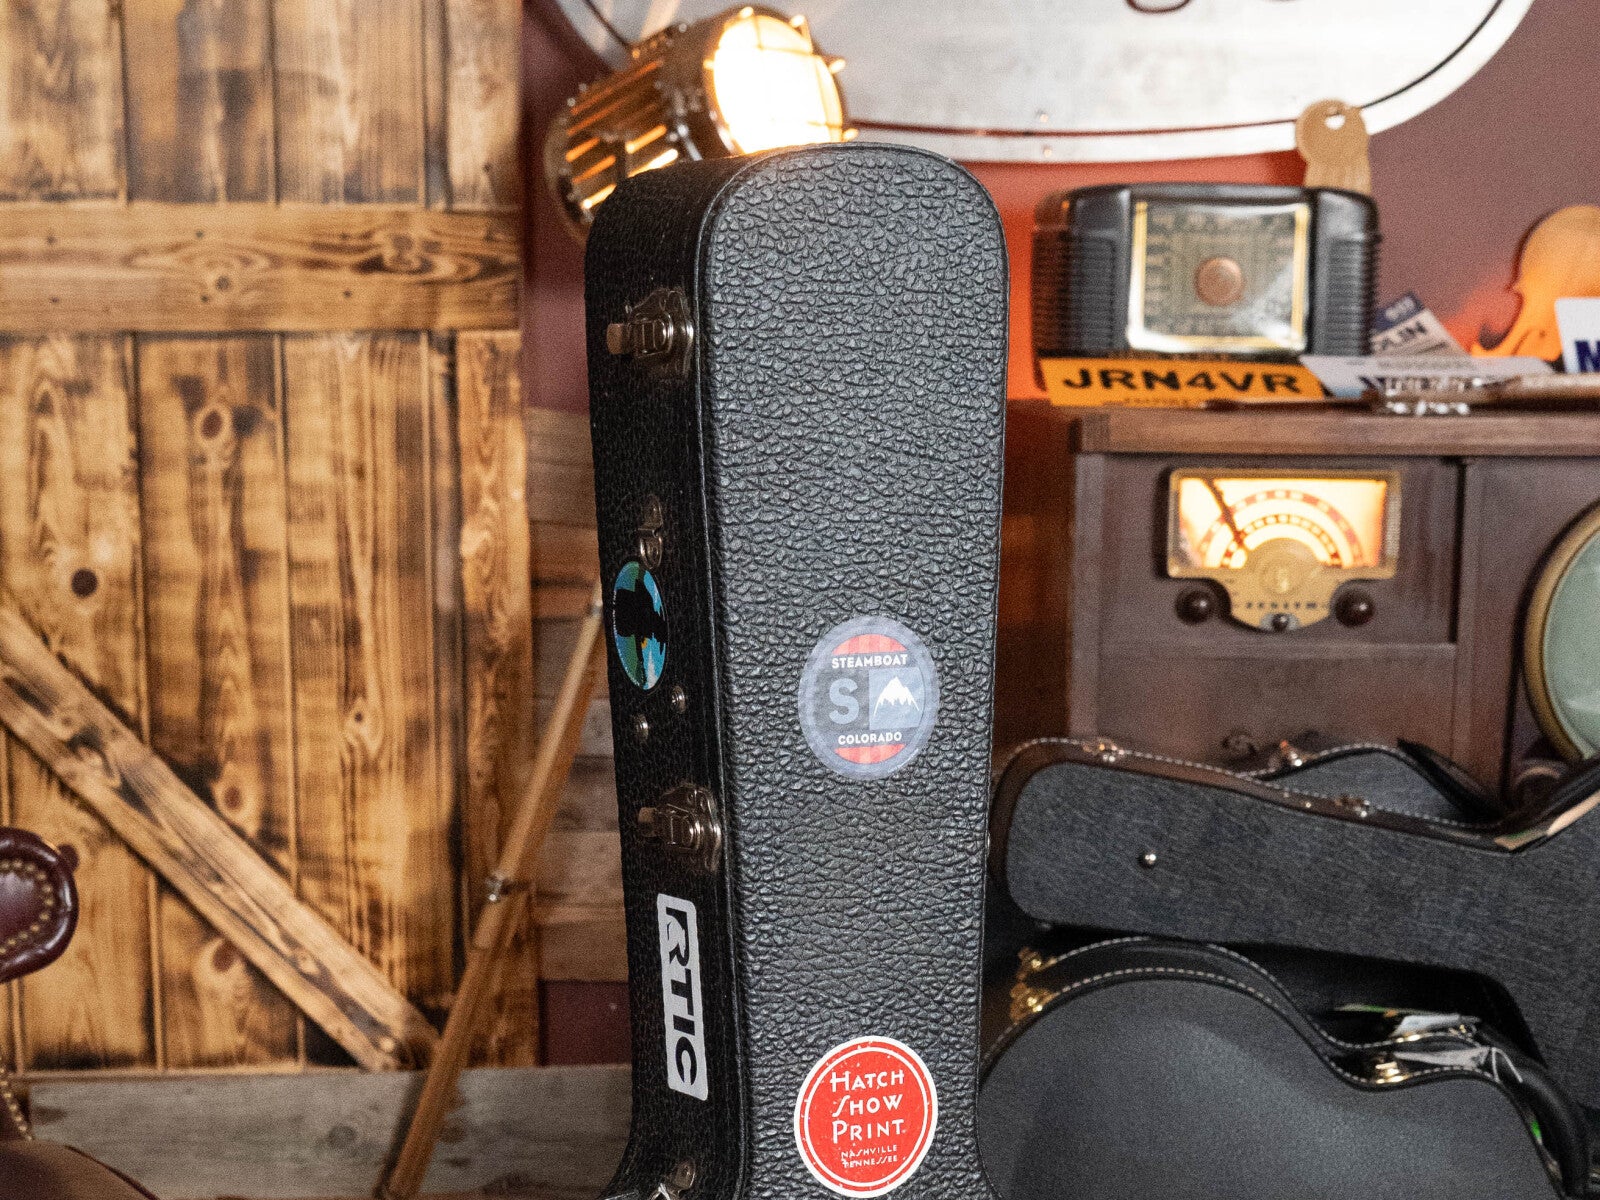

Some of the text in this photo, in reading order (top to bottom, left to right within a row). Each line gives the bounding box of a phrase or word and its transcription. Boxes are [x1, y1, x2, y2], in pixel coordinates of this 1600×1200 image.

[1064, 368, 1301, 393] JRN4VR
[831, 654, 908, 669] STEAMBOAT
[829, 678, 860, 725] S
[838, 732, 902, 745] COLORADO
[666, 907, 697, 1086] RTIC
[830, 1069, 905, 1093] HATCH
[832, 1094, 903, 1118] SHOW
[832, 1119, 904, 1144] PRINT
[841, 1144, 898, 1159] NASHVILLE
[841, 1155, 898, 1168] TENNESSEE
